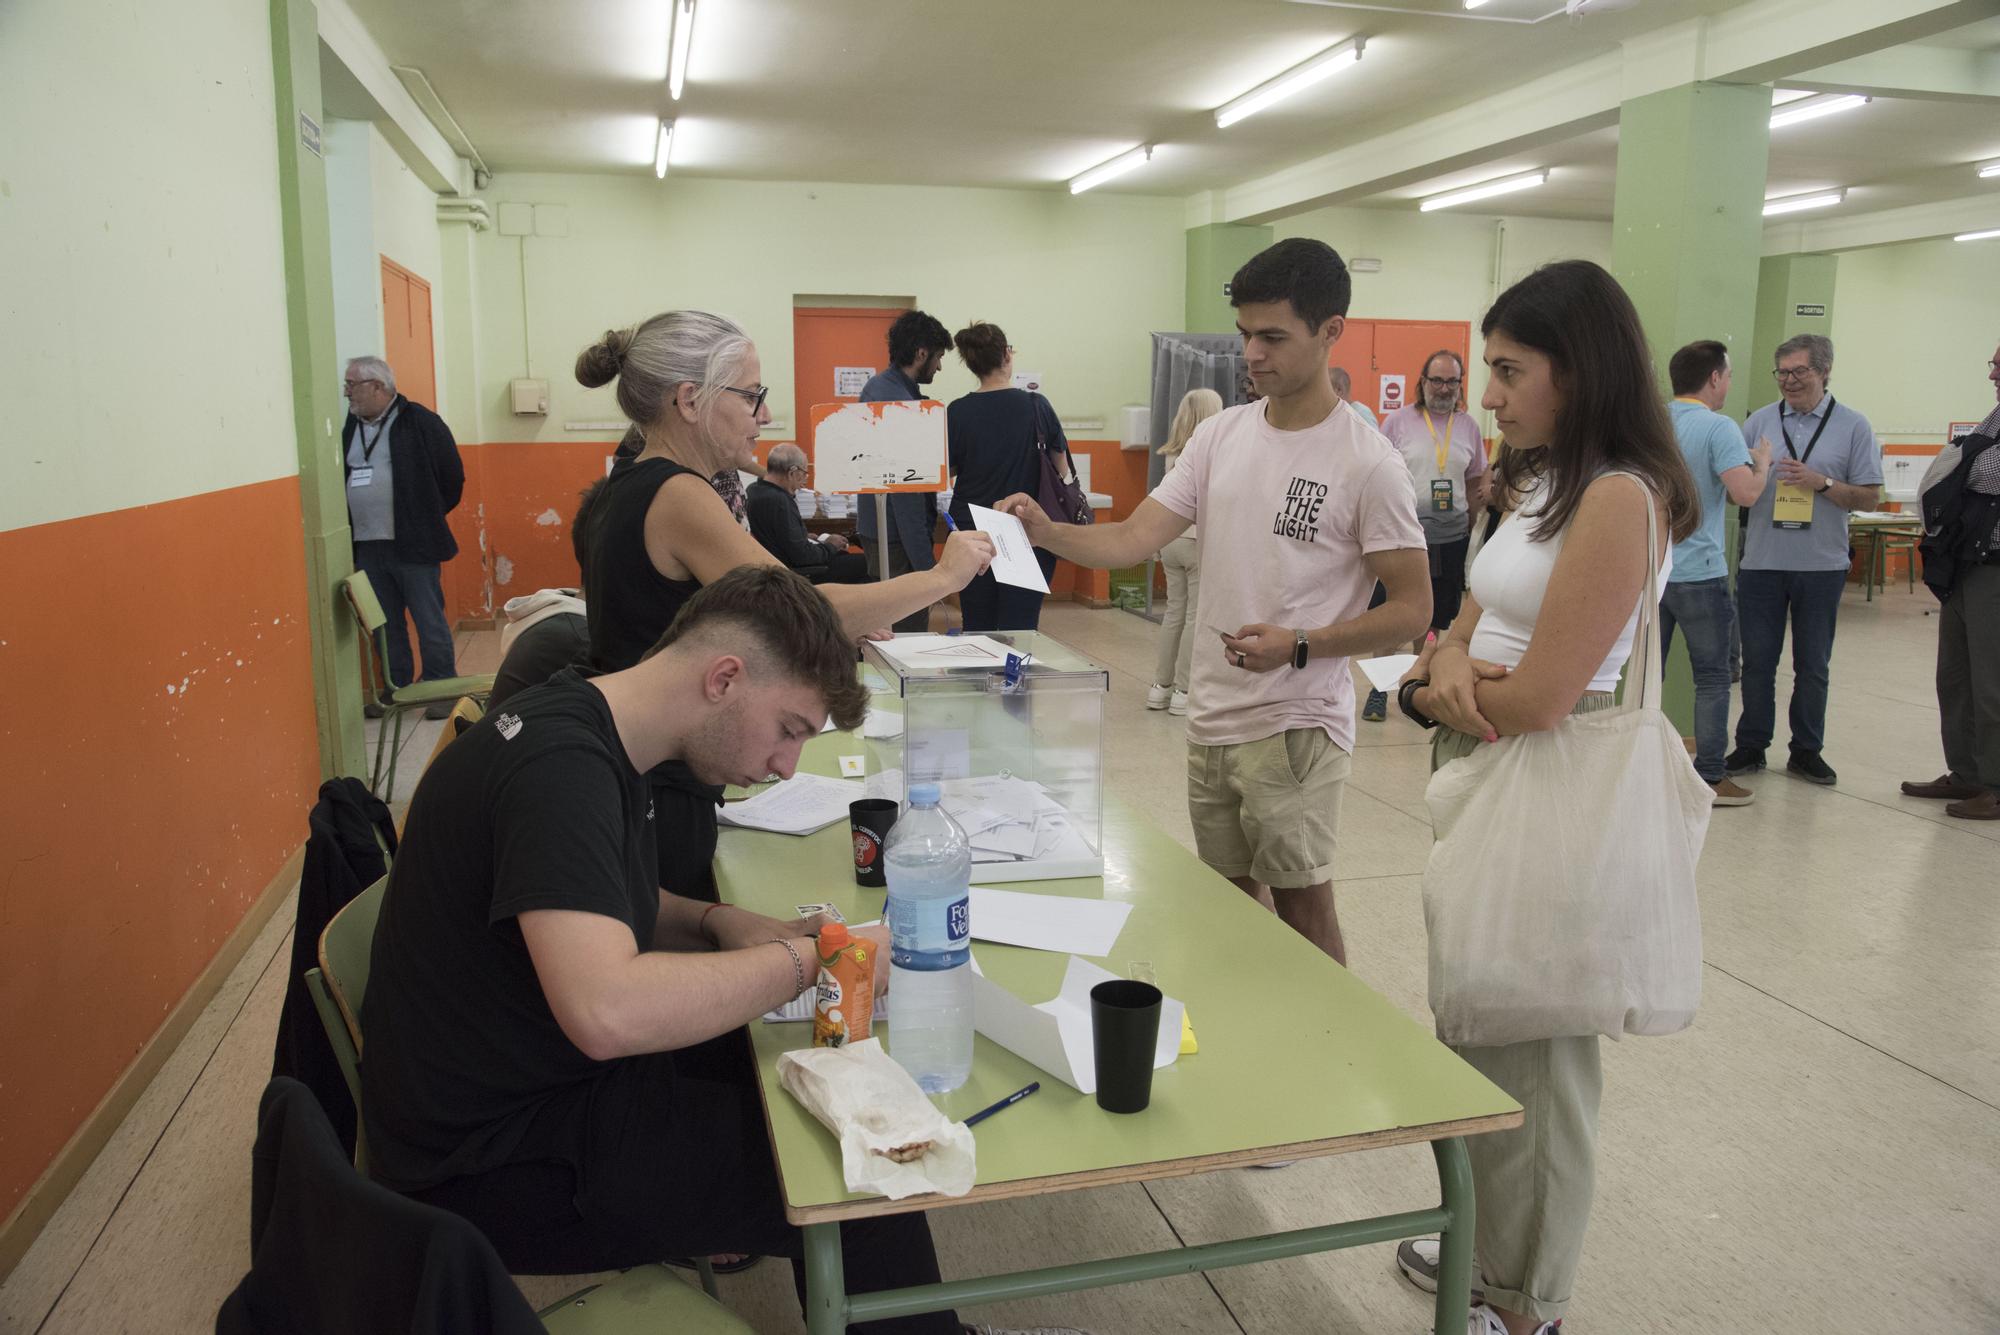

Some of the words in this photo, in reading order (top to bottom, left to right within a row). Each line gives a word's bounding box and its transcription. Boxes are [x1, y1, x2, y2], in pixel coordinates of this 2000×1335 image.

[902, 469, 925, 482] 2
[1286, 476, 1328, 498] INTO
[1285, 496, 1325, 524] THE
